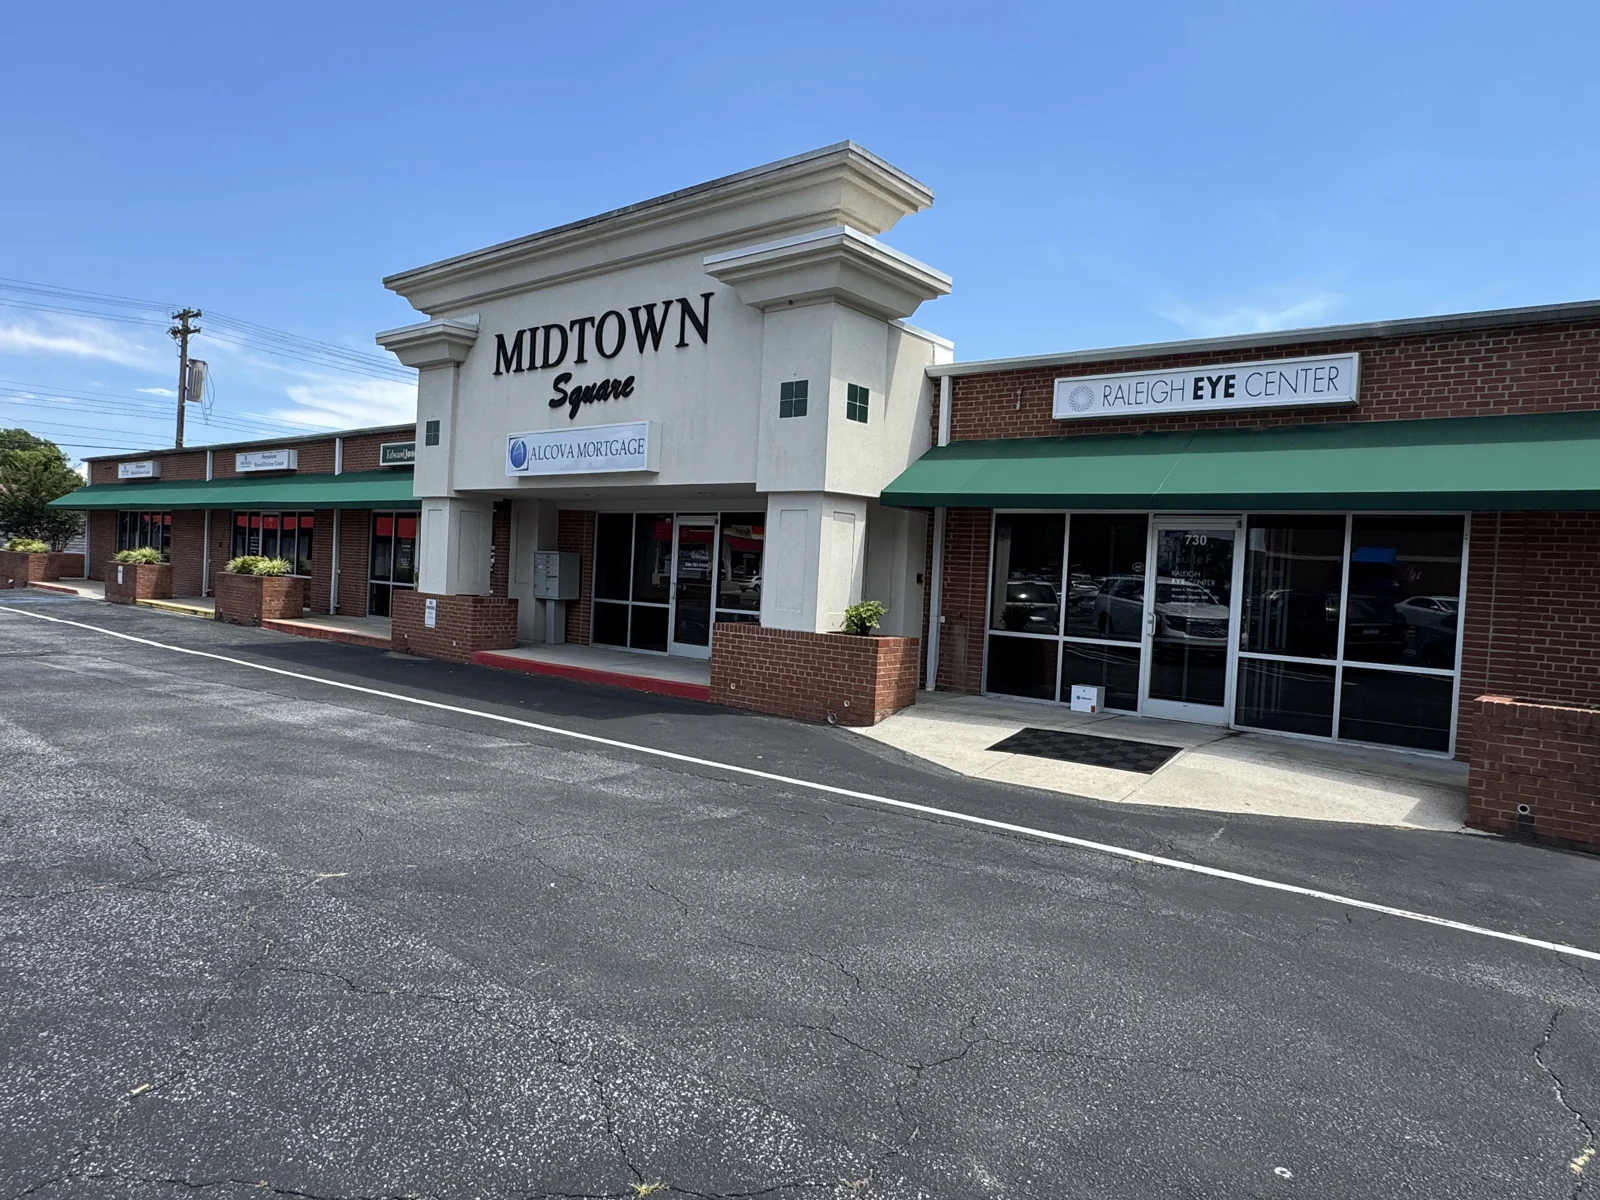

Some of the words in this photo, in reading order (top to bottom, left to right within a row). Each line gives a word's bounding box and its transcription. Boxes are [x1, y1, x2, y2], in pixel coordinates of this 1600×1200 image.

[492, 292, 715, 376] MIDTOWN
[1101, 377, 1186, 408] RALEIGH
[1192, 374, 1236, 400] EYE
[1244, 365, 1340, 397] CENTER
[548, 372, 635, 420] Square
[404, 449, 416, 459] Jon
[529, 443, 574, 461] ALCOVA
[576, 438, 645, 458] MORTGAGE
[1185, 534, 1207, 546] 730
[1171, 570, 1201, 578] RALEIGH
[1188, 579, 1216, 587] CENTER
